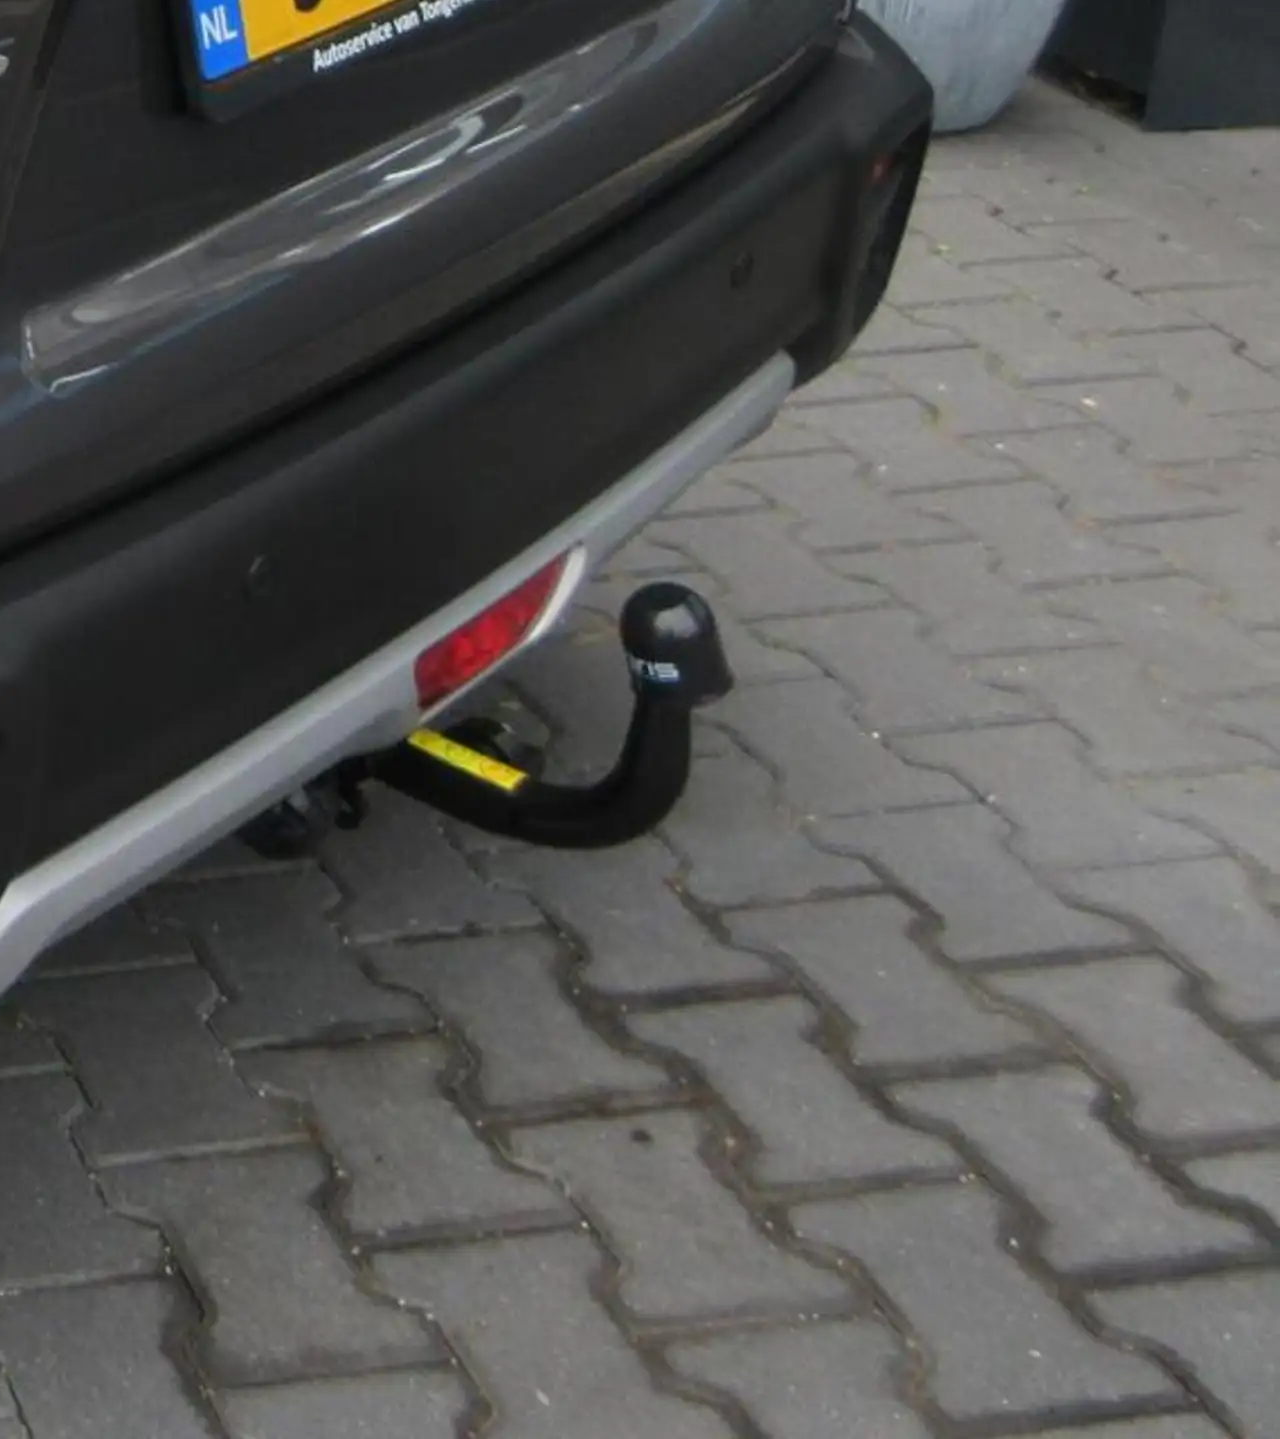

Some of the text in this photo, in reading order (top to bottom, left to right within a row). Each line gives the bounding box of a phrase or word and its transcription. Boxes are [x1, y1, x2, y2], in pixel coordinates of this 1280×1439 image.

[199, 4, 238, 51] NL
[312, 21, 393, 73] Autoservice
[393, 9, 421, 35] van
